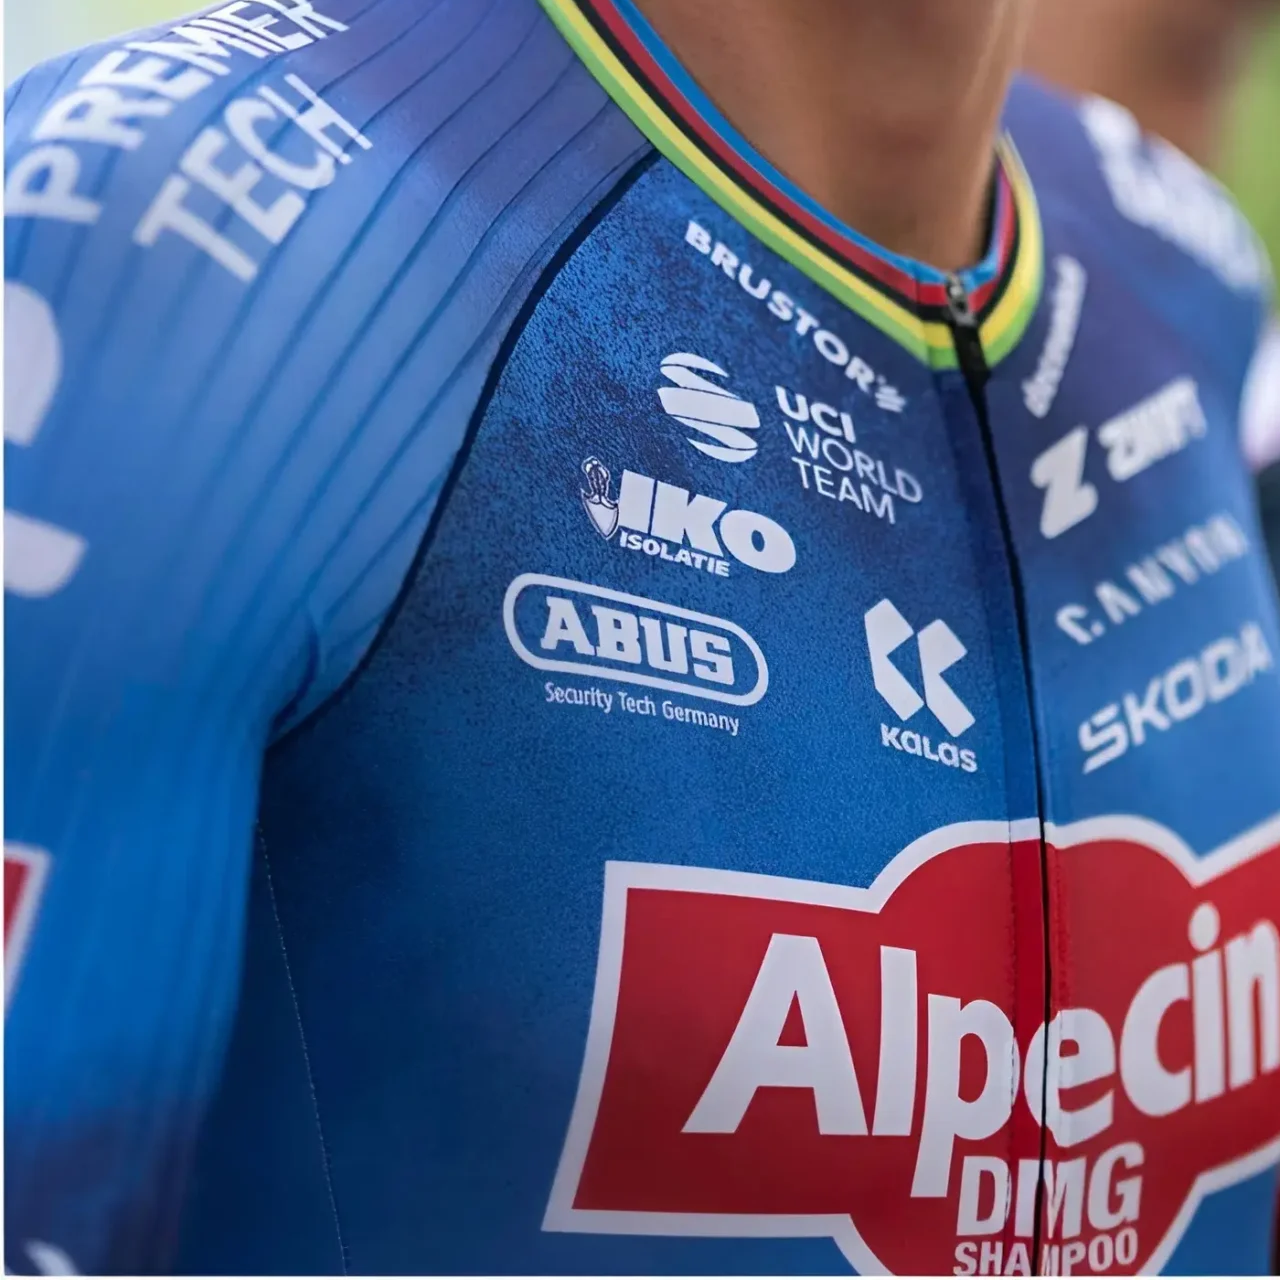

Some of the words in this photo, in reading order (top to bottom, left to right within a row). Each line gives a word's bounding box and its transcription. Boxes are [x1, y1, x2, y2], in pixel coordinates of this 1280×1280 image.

[133, 73, 372, 282] TECH
[775, 385, 856, 444] UCI
[783, 422, 922, 503] WORLD
[791, 458, 896, 524] TEAM
[615, 469, 796, 574] IKO
[619, 529, 730, 577] ISOLATIE
[540, 596, 735, 686] ABUS
[545, 680, 613, 714] Security
[619, 692, 656, 717] Tech
[662, 699, 739, 736] Germany
[1078, 621, 1274, 775] SKODA
[956, 1141, 1144, 1239] DMG
